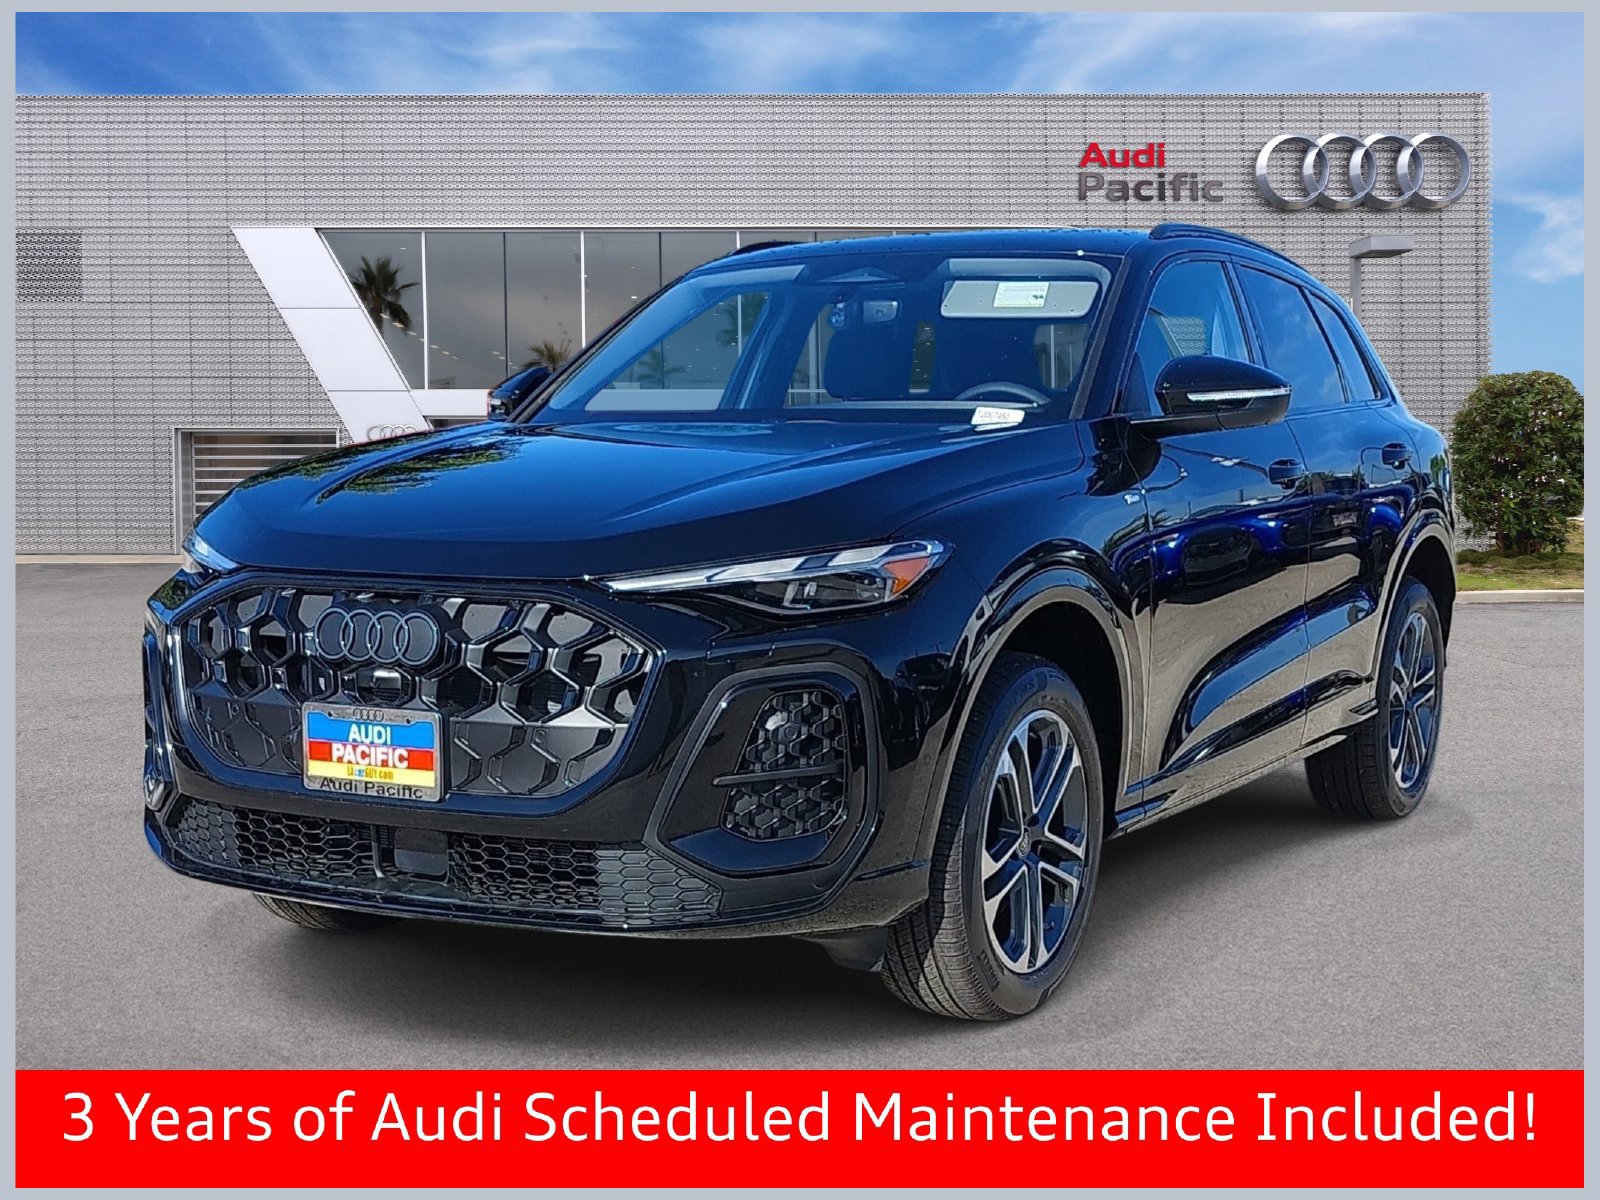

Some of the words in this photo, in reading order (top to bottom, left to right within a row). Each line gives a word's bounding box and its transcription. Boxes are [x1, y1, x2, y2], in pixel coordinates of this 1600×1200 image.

[1078, 142, 1166, 168] Audi
[1078, 171, 1224, 202] Pacific
[348, 724, 392, 745] AUDI
[331, 743, 409, 769] PACIFIC
[319, 777, 359, 793] Audi
[364, 781, 423, 799] Pacific
